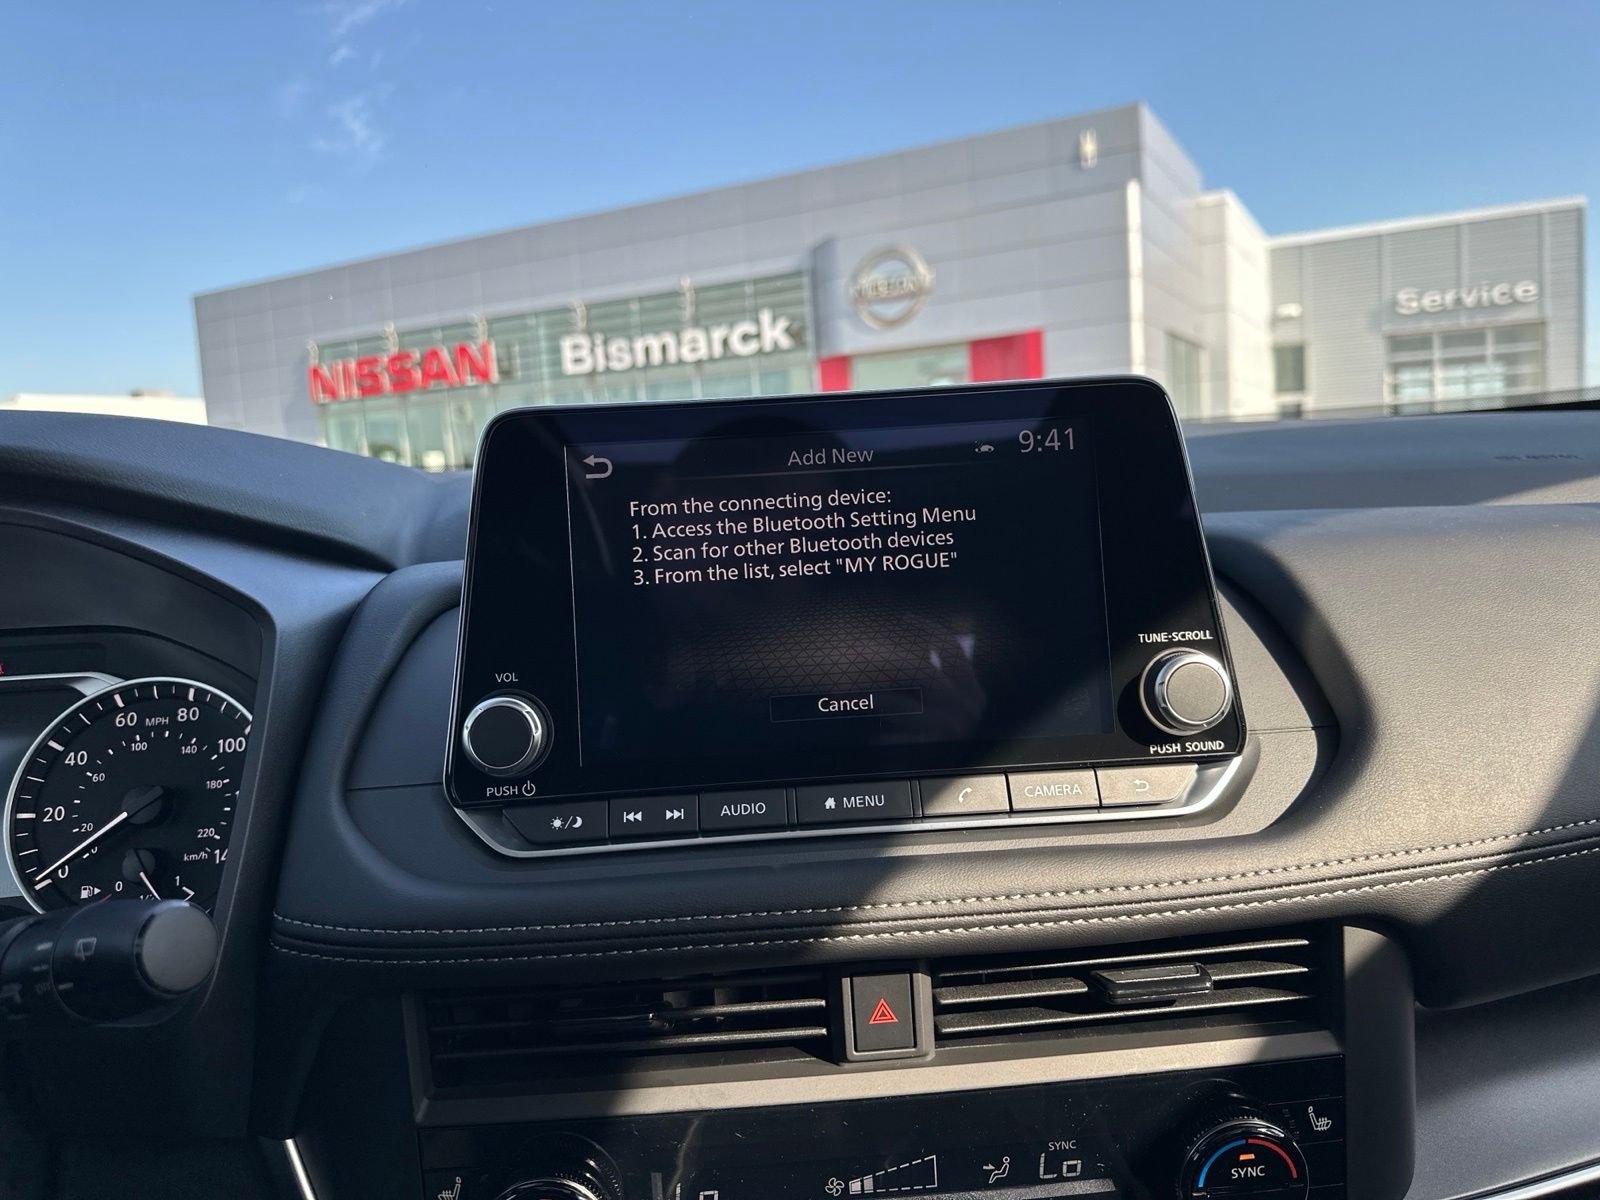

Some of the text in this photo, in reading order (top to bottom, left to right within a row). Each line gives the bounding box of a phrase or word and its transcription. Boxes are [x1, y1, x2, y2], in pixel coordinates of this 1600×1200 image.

[1395, 278, 1539, 315] Service
[560, 307, 794, 376] Bismarck
[309, 340, 499, 405] NISSAN
[1019, 428, 1076, 452] 9:41
[788, 447, 874, 466] Add New
[630, 488, 892, 517] From the connecting device:
[632, 507, 976, 539] 1. Access the Bluetooth Setting Menu
[633, 530, 954, 562] 2. Scan for other Bluetooth devices
[634, 551, 957, 585] 3. From the list, select "MY ROGUE"
[495, 672, 518, 683] VOL
[818, 694, 874, 712] Cancel
[115, 712, 137, 727] 60
[145, 716, 169, 726] MPH
[177, 707, 199, 721] 80
[131, 742, 148, 752] 100
[181, 745, 198, 754] 140
[217, 737, 246, 753] 100
[1150, 740, 1225, 754] PUSH SOUND
[64, 751, 88, 766] 40
[92, 772, 106, 782] 60
[206, 779, 223, 789] 180
[486, 785, 518, 797] PUSH
[1024, 784, 1083, 797] CAMERA
[843, 794, 885, 809] MENU
[43, 806, 65, 822] 20
[720, 802, 766, 816] AUDIO
[80, 823, 94, 832] 20
[197, 828, 216, 839] 220
[183, 851, 208, 862] km/h
[57, 864, 69, 879] 0
[115, 881, 123, 892] 0
[1048, 1140, 1077, 1151] SYNC
[1039, 1152, 1082, 1179] Lo
[1231, 1165, 1266, 1179] SYNC
